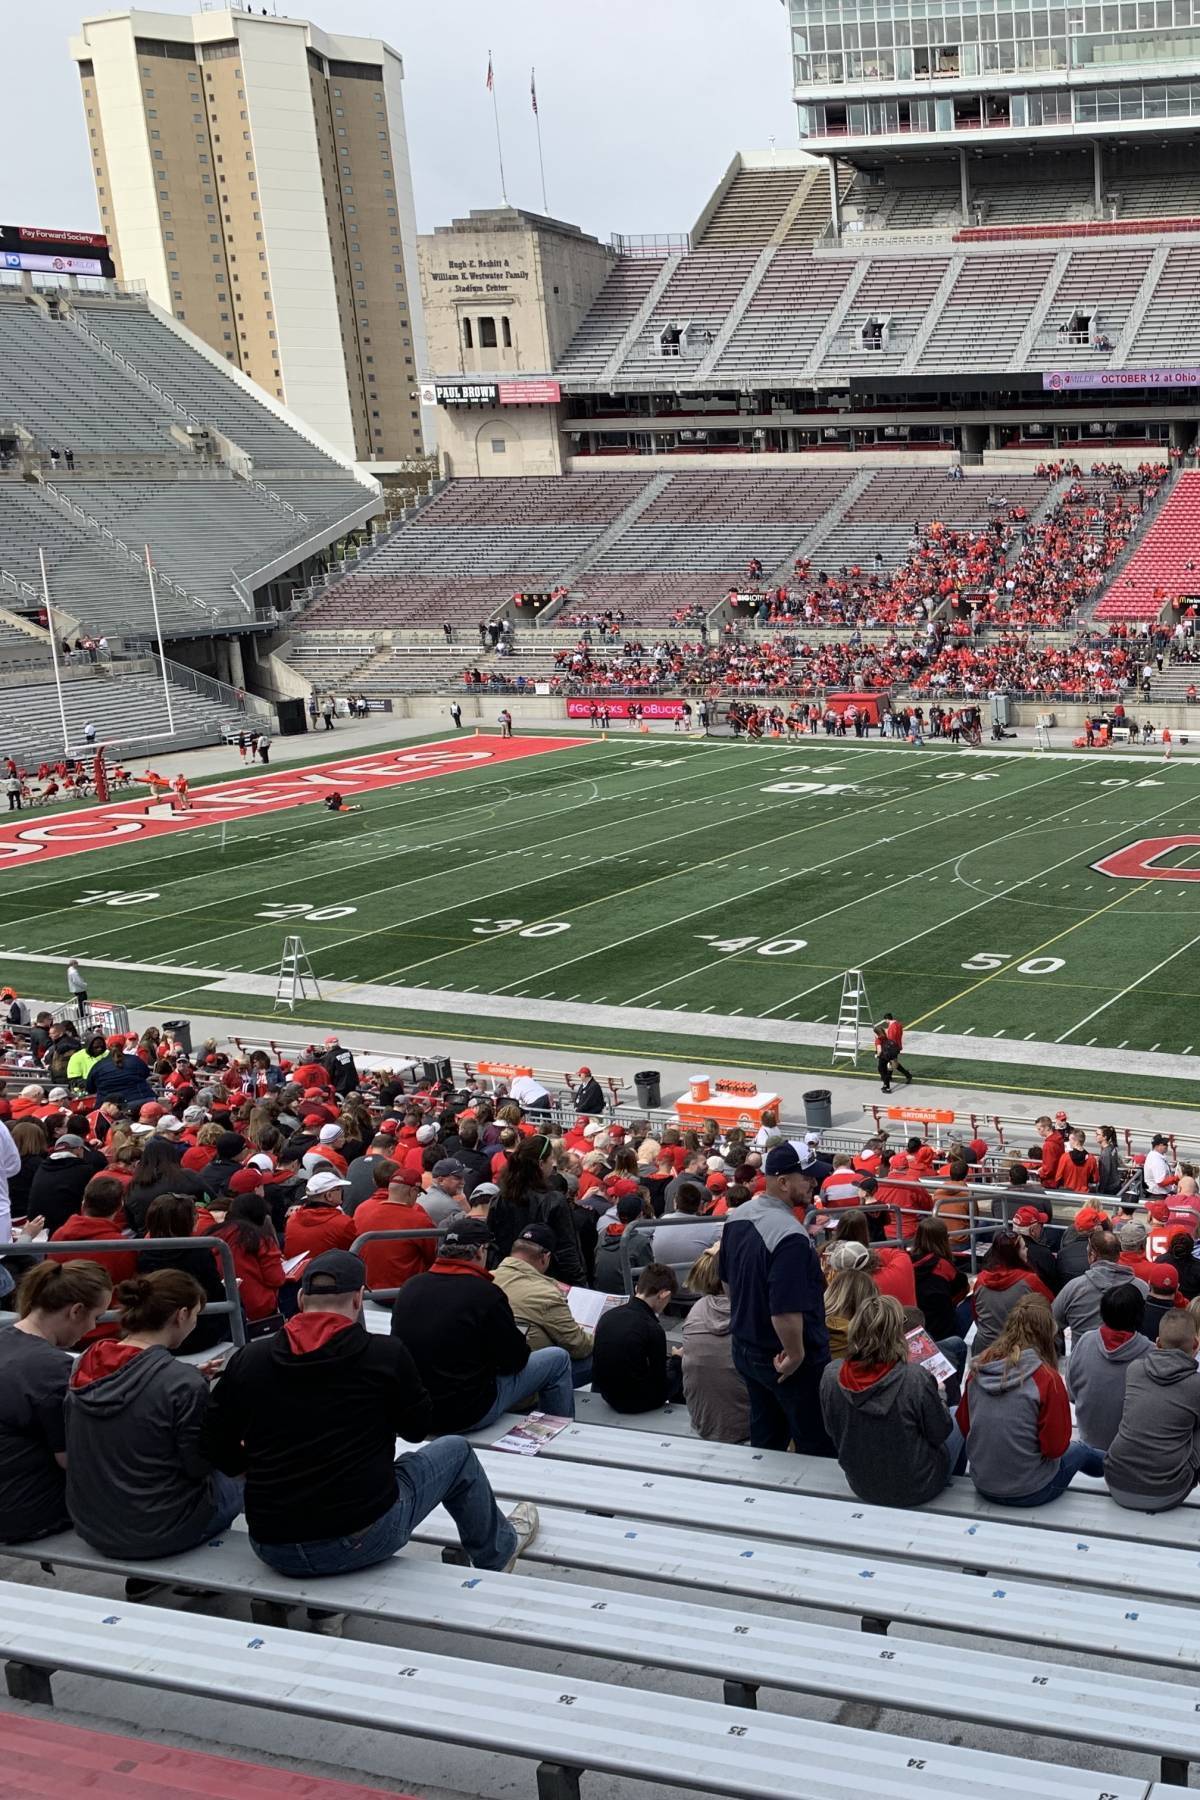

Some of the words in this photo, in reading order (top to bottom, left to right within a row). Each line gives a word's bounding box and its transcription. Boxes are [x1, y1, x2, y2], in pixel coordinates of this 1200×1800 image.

[21, 228, 36, 239] Pay
[36, 229, 67, 240] Forward
[66, 232, 94, 244] Society
[449, 260, 467, 270] Hugh
[432, 273, 459, 281] William
[469, 272, 503, 280] Westwater
[505, 271, 529, 280] Family
[455, 285, 484, 293] Stadium
[486, 284, 508, 292] Center
[1101, 375, 1147, 384] OCTOBER
[1149, 374, 1160, 382] 12
[1163, 374, 1173, 383] at
[1175, 373, 1197, 382] Ohio
[437, 386, 461, 398] PAUL
[461, 385, 496, 398] BROWN
[255, 903, 358, 921] 20
[472, 918, 572, 938] 30
[707, 936, 808, 956] 40
[960, 952, 1066, 975] 50
[901, 1111, 937, 1121] GATORADE
[735, 1626, 749, 1634] 26
[880, 1651, 896, 1659] 25
[398, 1668, 418, 1676] 27
[1032, 1676, 1048, 1685] 24
[558, 1695, 577, 1705] 26
[728, 1726, 747, 1736] 25
[907, 1759, 926, 1769] 24
